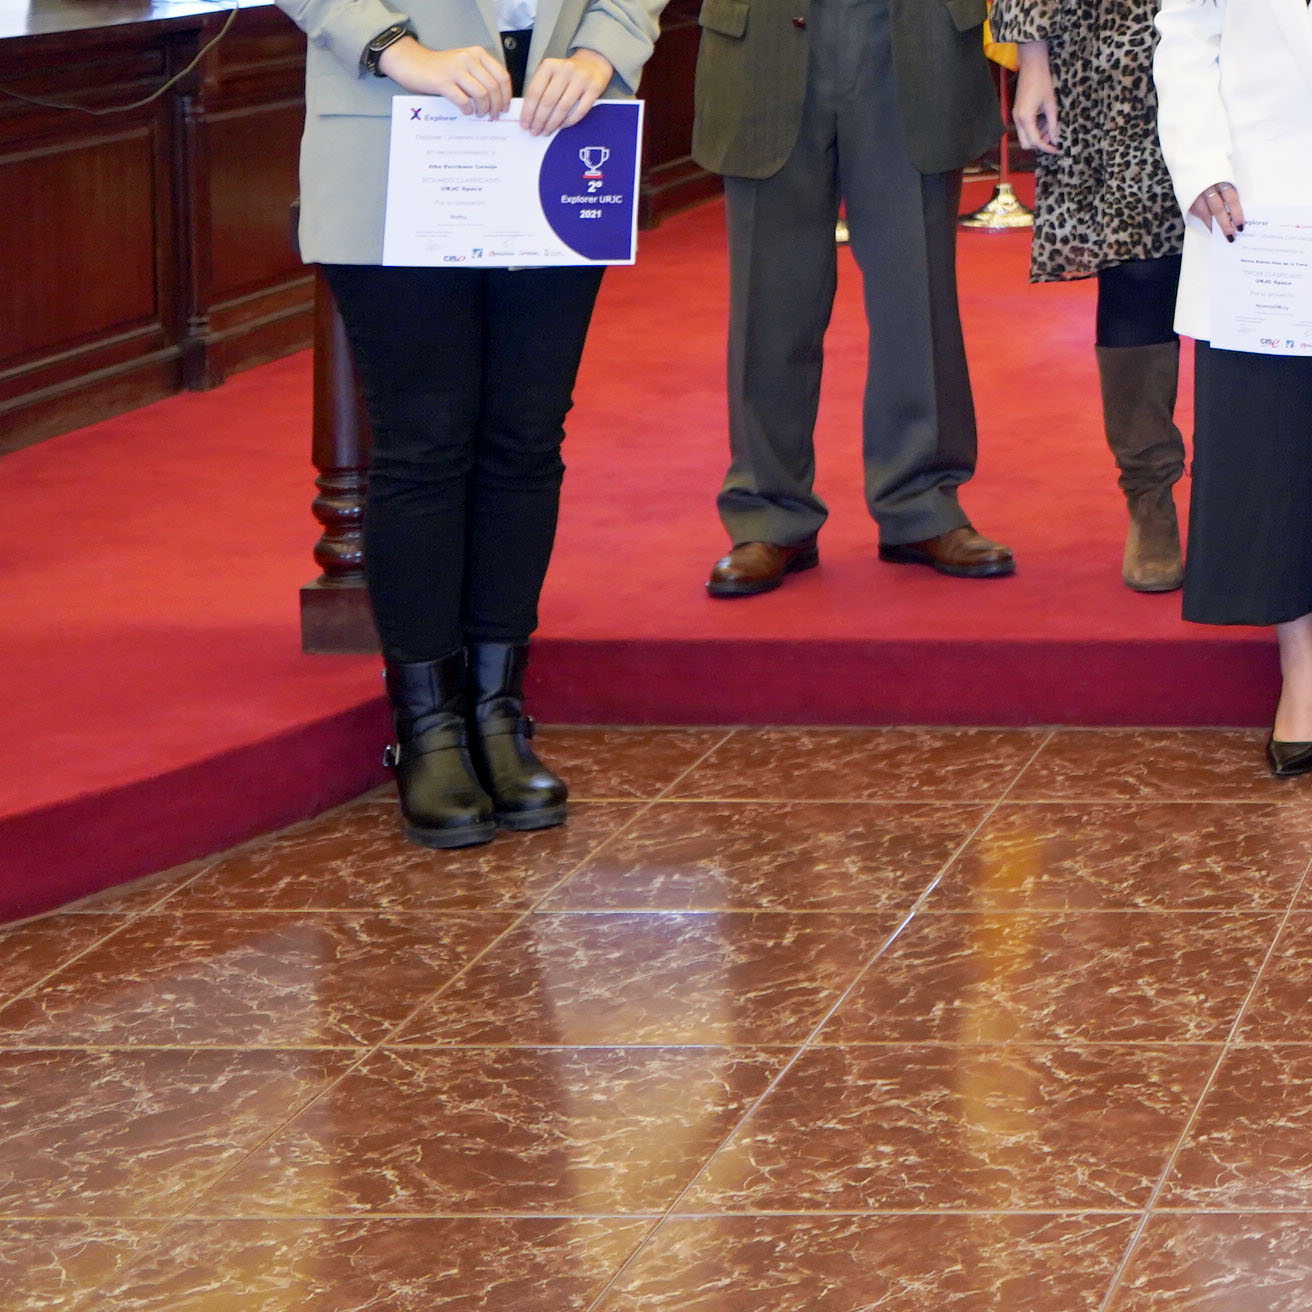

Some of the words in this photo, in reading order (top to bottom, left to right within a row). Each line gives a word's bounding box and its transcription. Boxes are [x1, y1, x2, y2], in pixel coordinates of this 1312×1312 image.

[424, 115, 458, 123] Explorer
[587, 181, 603, 193] 2º
[561, 195, 597, 204] Explorer
[599, 195, 622, 203] URJC
[579, 209, 602, 218] 2021
